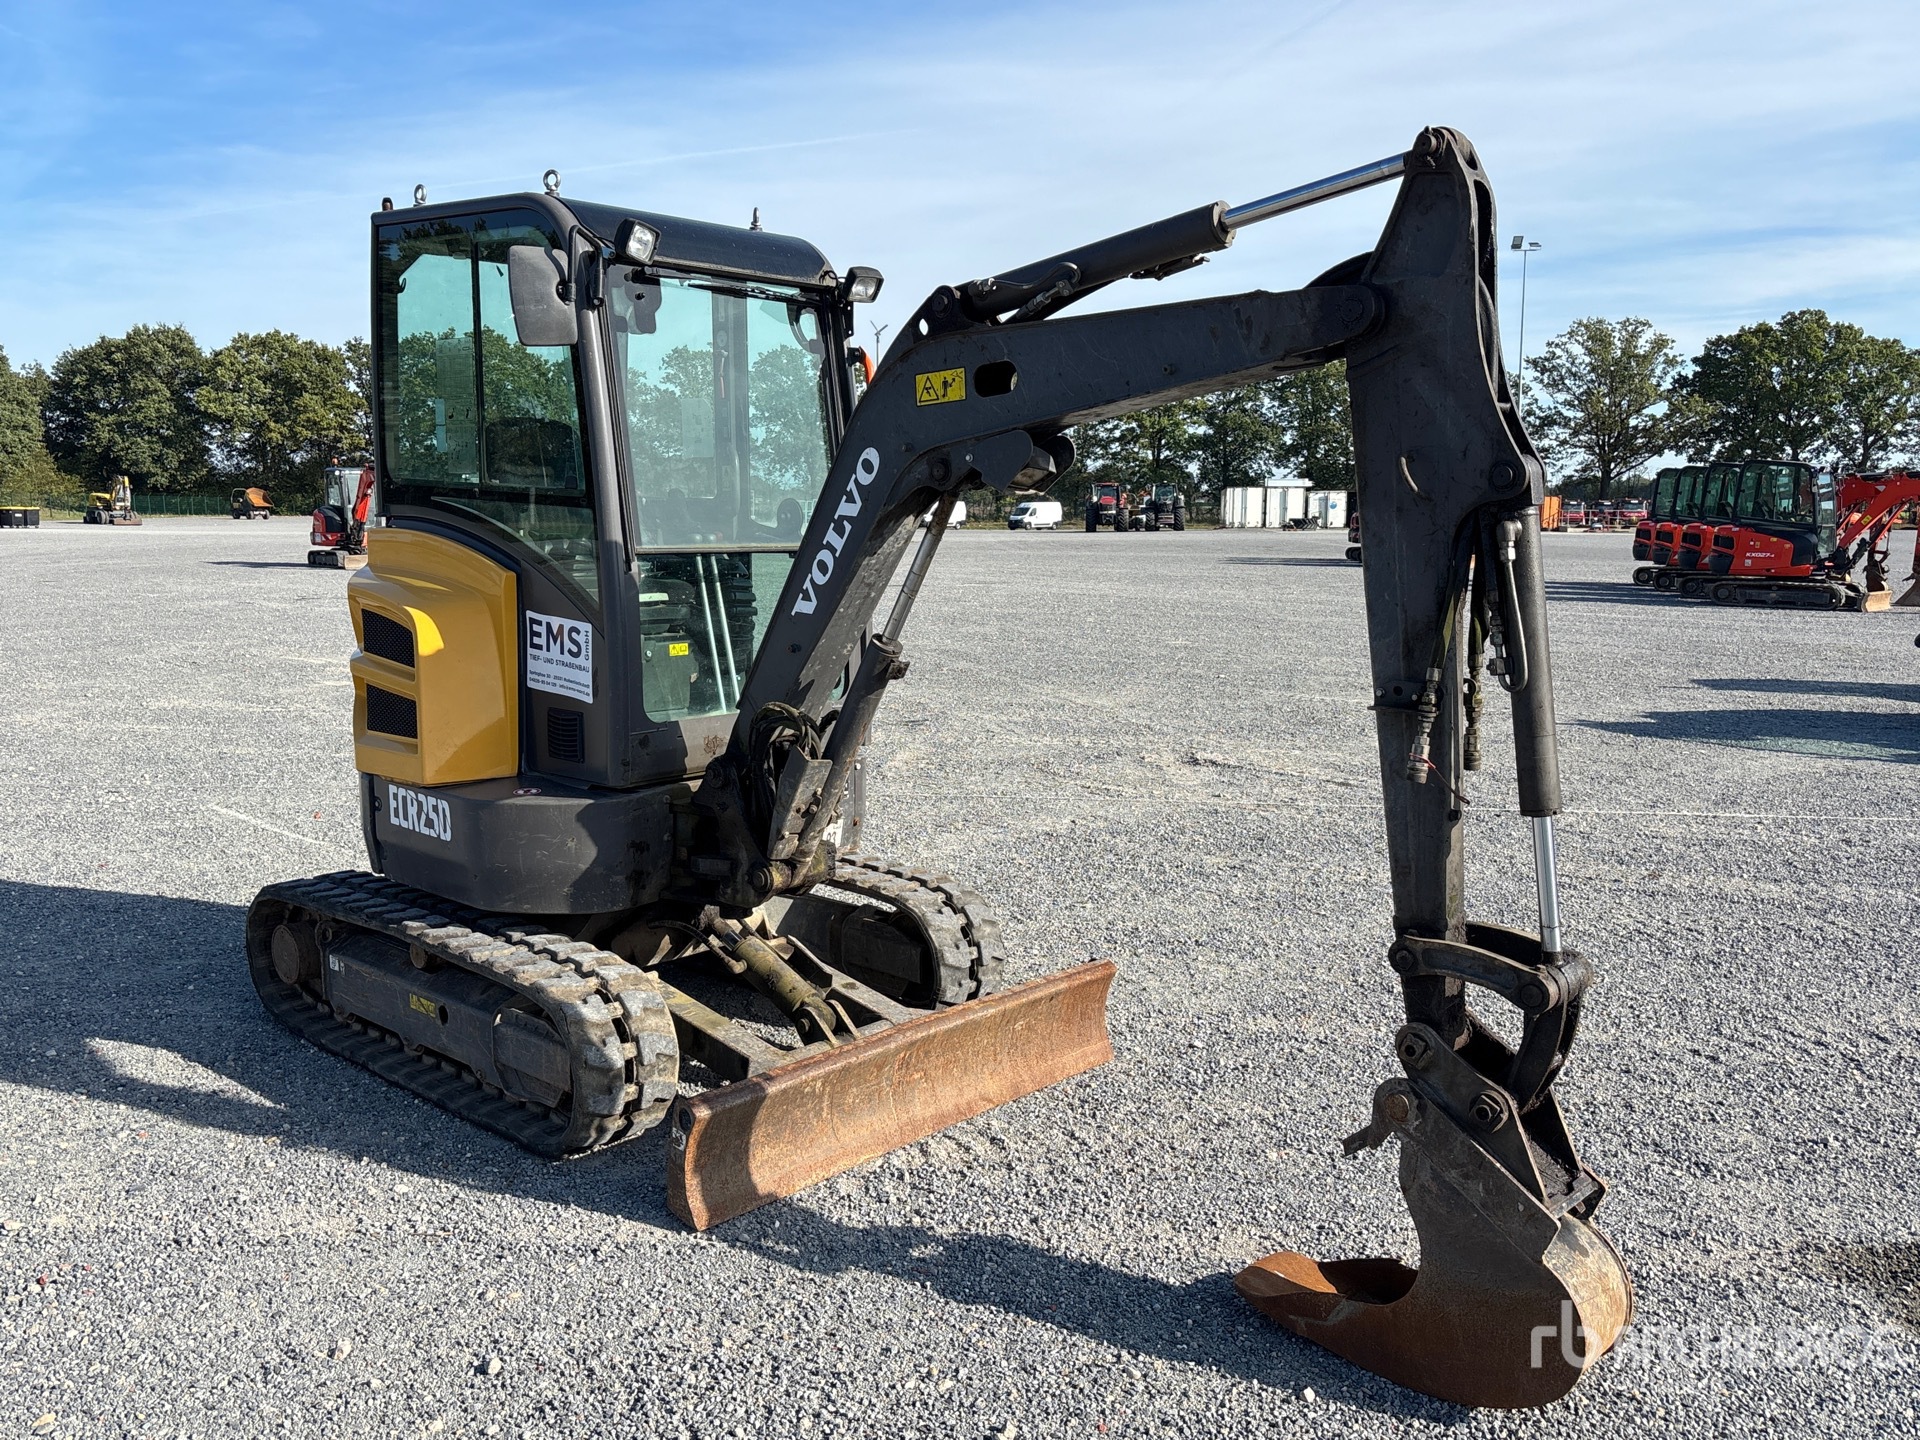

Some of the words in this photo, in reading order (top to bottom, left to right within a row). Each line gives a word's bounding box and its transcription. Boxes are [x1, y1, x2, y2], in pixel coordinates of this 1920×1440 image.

[791, 447, 880, 616] VOLVO
[528, 617, 582, 659] EMS
[529, 653, 542, 662] TIEF-
[543, 656, 554, 665] UND
[388, 783, 452, 842] ECR25D
